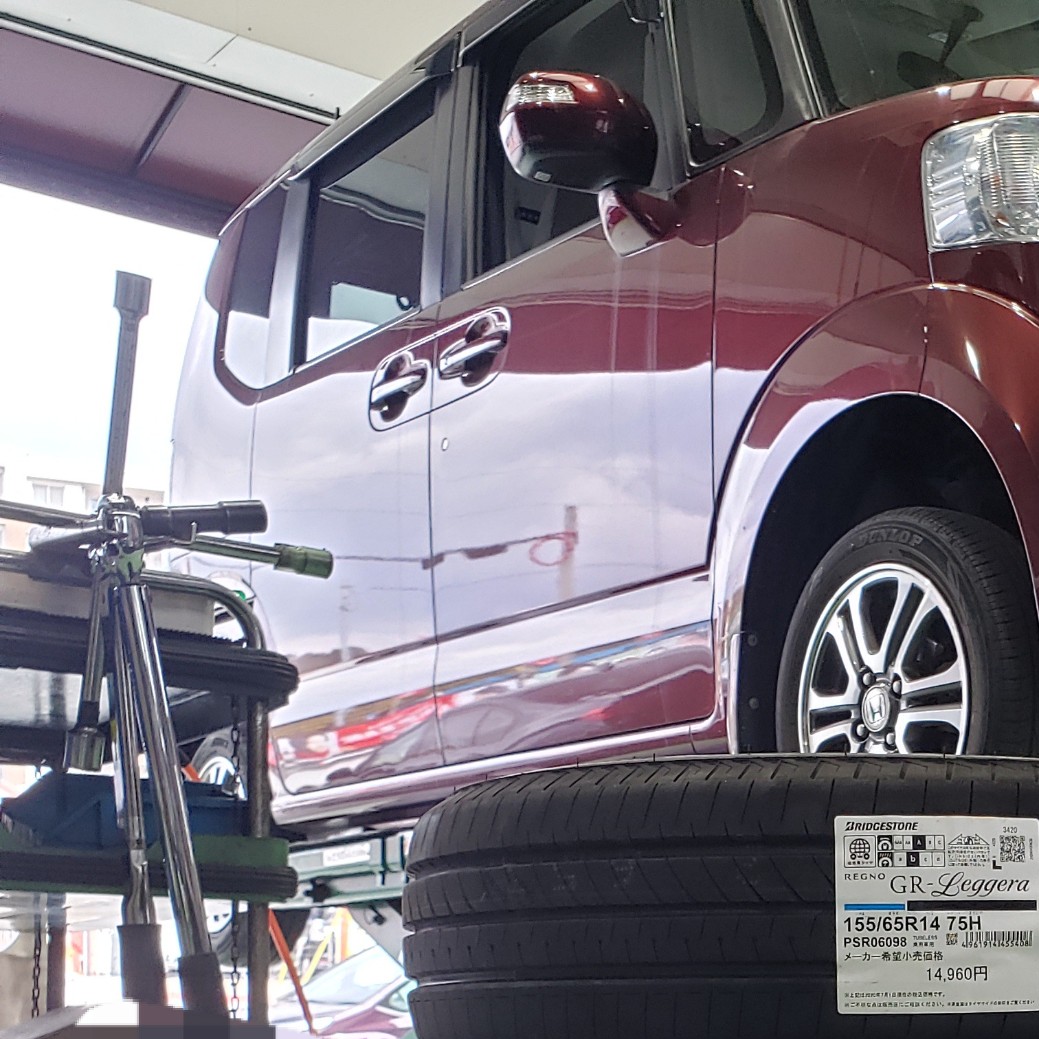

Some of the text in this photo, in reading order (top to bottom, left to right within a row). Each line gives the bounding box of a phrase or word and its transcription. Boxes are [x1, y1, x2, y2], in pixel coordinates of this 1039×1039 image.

[845, 821, 919, 832] BRIDGESTONE
[1002, 826, 1018, 834] 3420
[844, 873, 886, 881] REGNO
[890, 871, 1030, 897] GR-Leggera
[843, 915, 982, 932] 155/65R14 75H
[843, 936, 907, 948] PSR06098
[843, 951, 943, 962] メーカー希望小売価格
[926, 965, 988, 982] 14,960円
